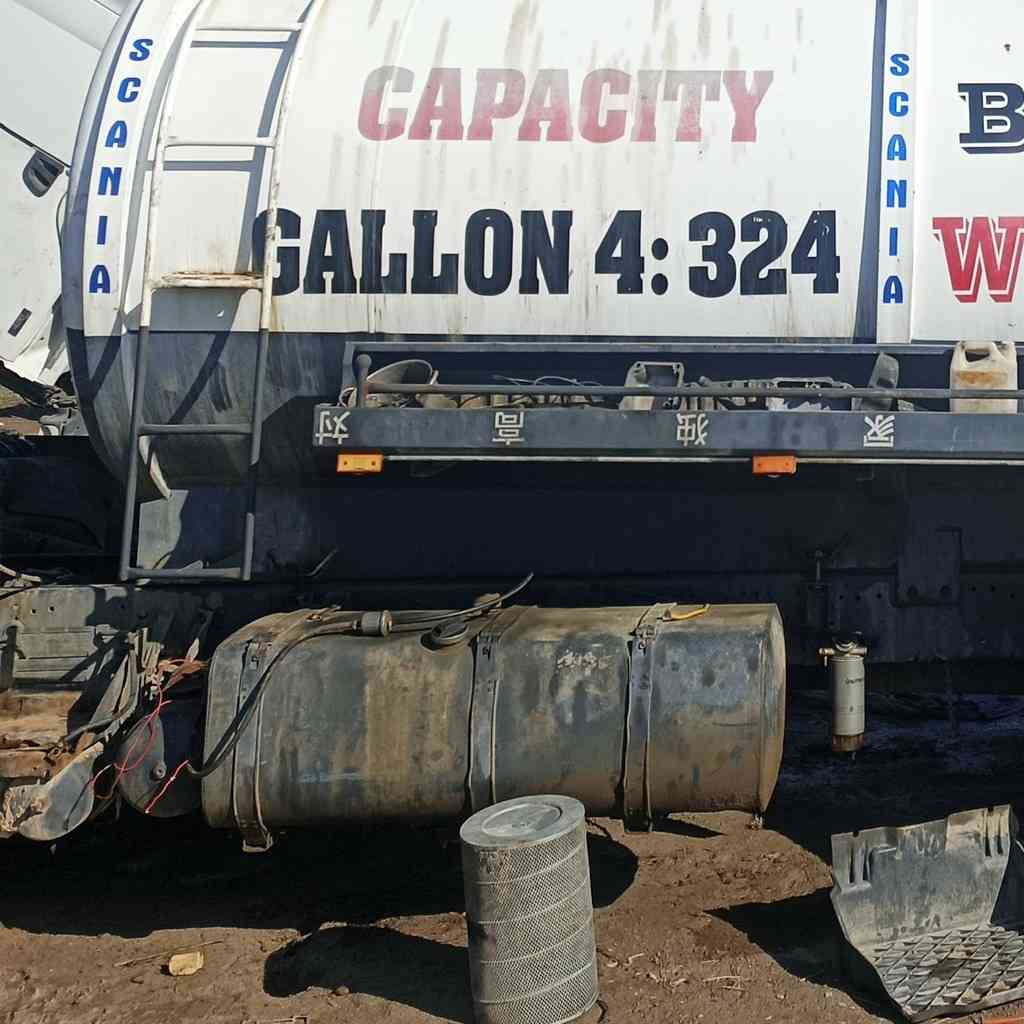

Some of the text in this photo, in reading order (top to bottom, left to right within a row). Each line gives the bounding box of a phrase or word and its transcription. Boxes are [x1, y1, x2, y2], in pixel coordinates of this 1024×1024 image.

[88, 38, 153, 294] SCANIA
[358, 65, 774, 143] CAPACITY
[883, 53, 910, 304] SCANIA
[252, 207, 573, 297] GALLON
